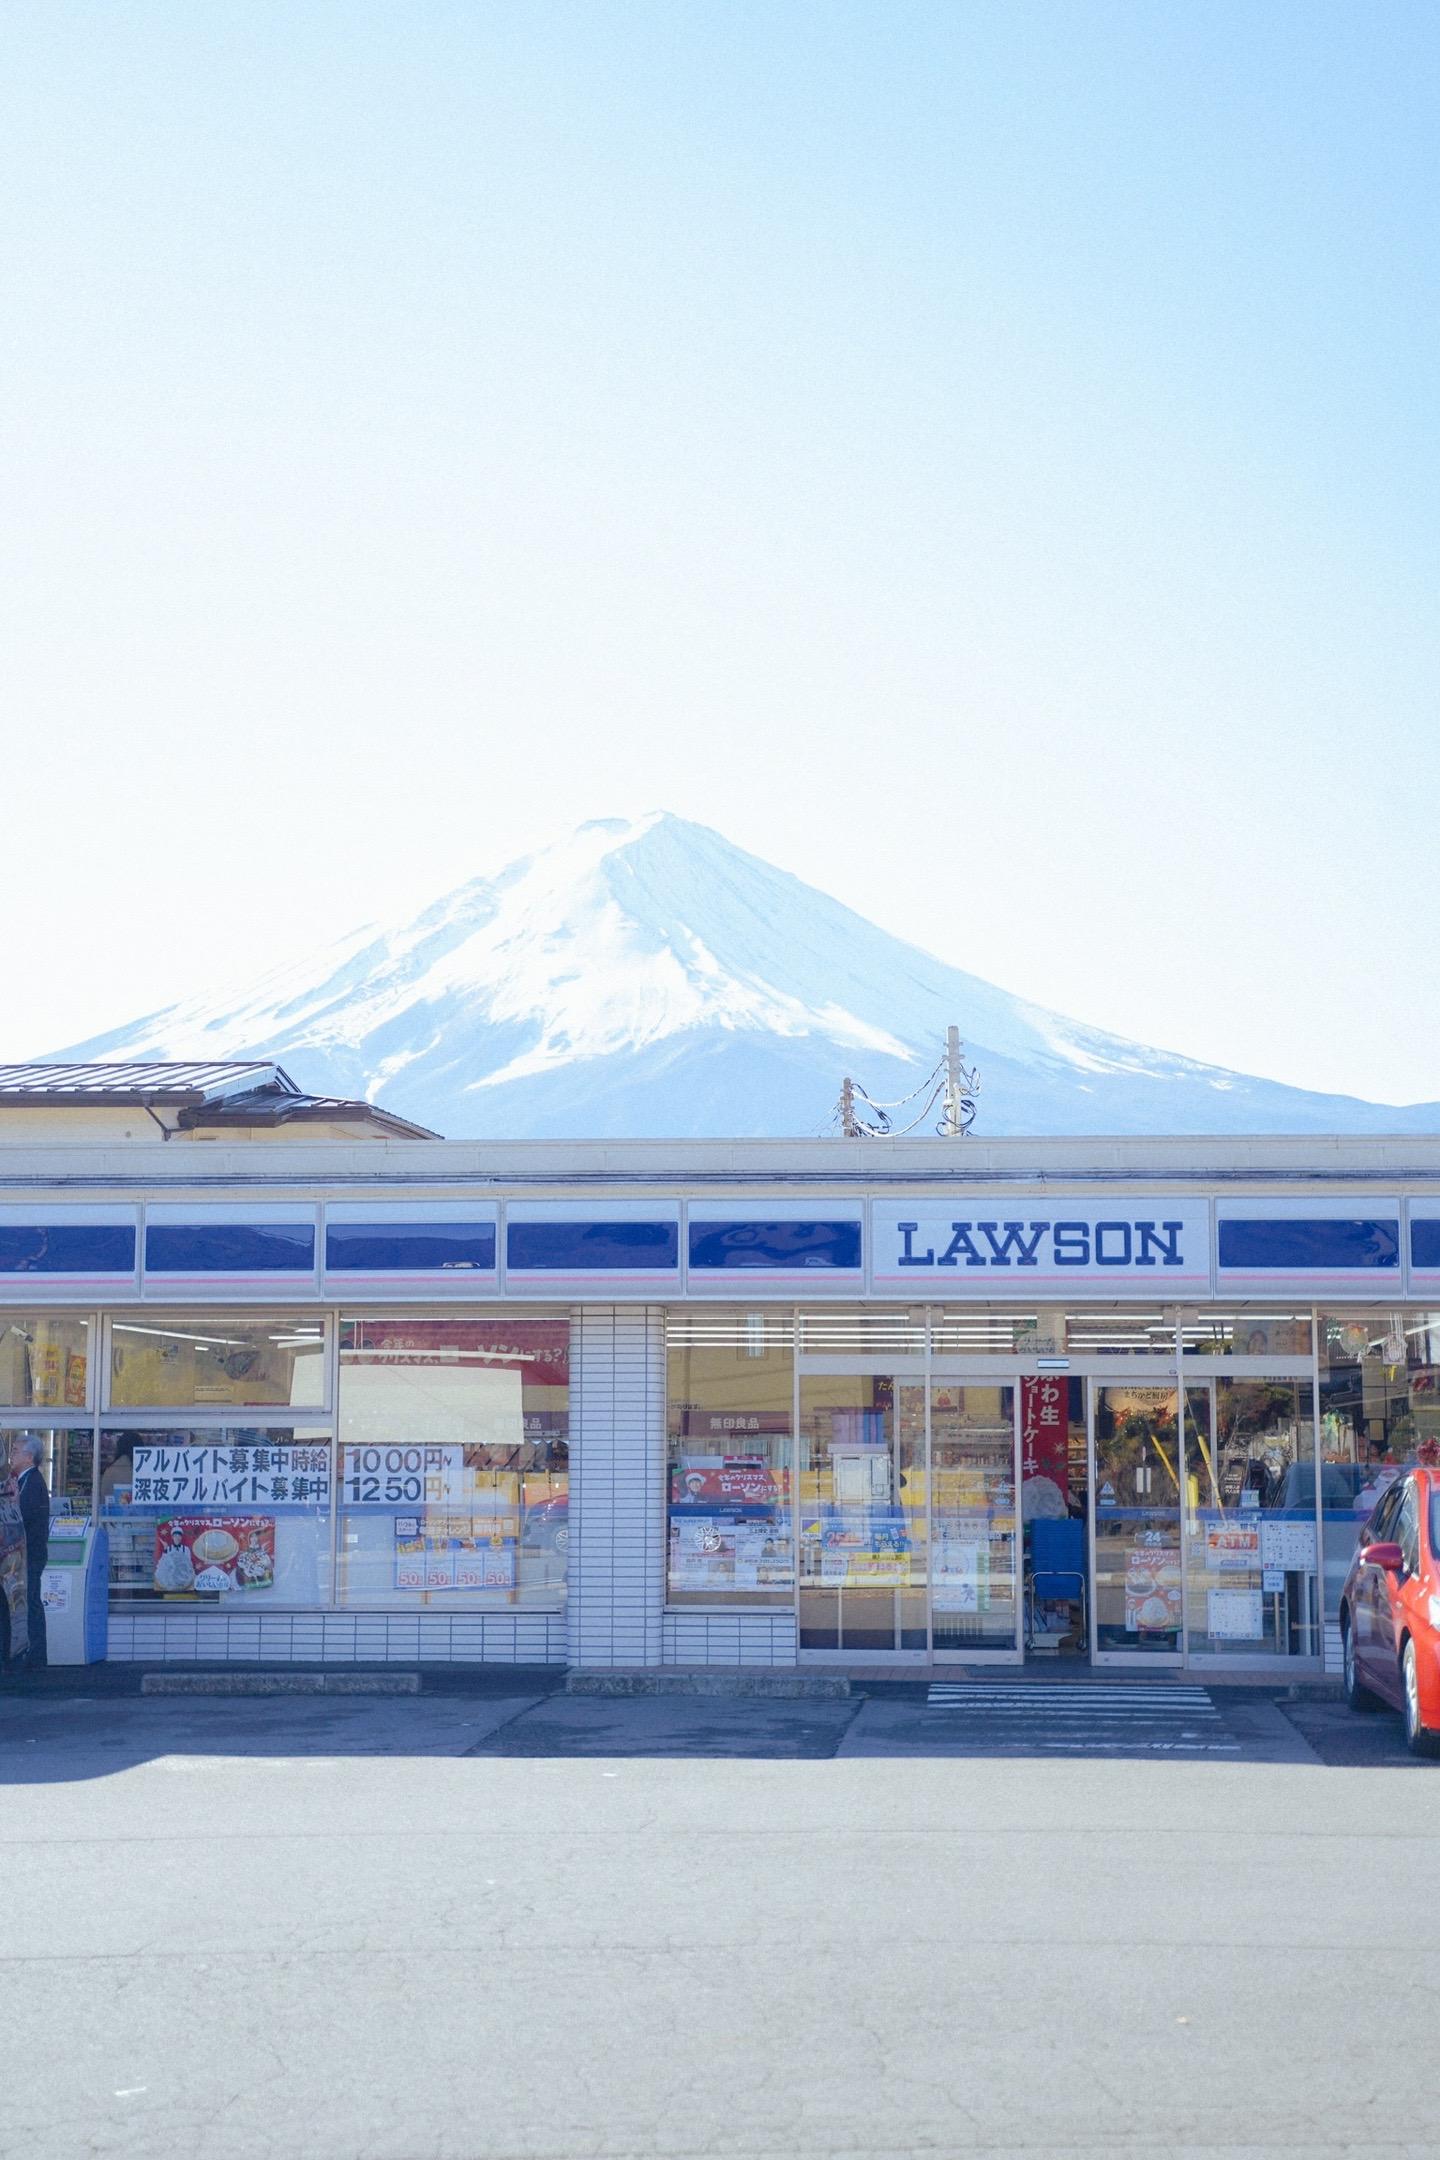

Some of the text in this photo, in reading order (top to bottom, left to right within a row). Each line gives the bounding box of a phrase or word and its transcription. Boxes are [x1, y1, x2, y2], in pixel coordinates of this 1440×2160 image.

[897, 1221, 1184, 1267] LAWSON
[710, 1417, 760, 1430] 無印良品
[134, 1448, 328, 1474] アルバイト募集中時給
[134, 1476, 329, 1502] 深夜アルバイト募集中
[1144, 1531, 1161, 1542] 24
[1217, 1536, 1252, 1548] ATM
